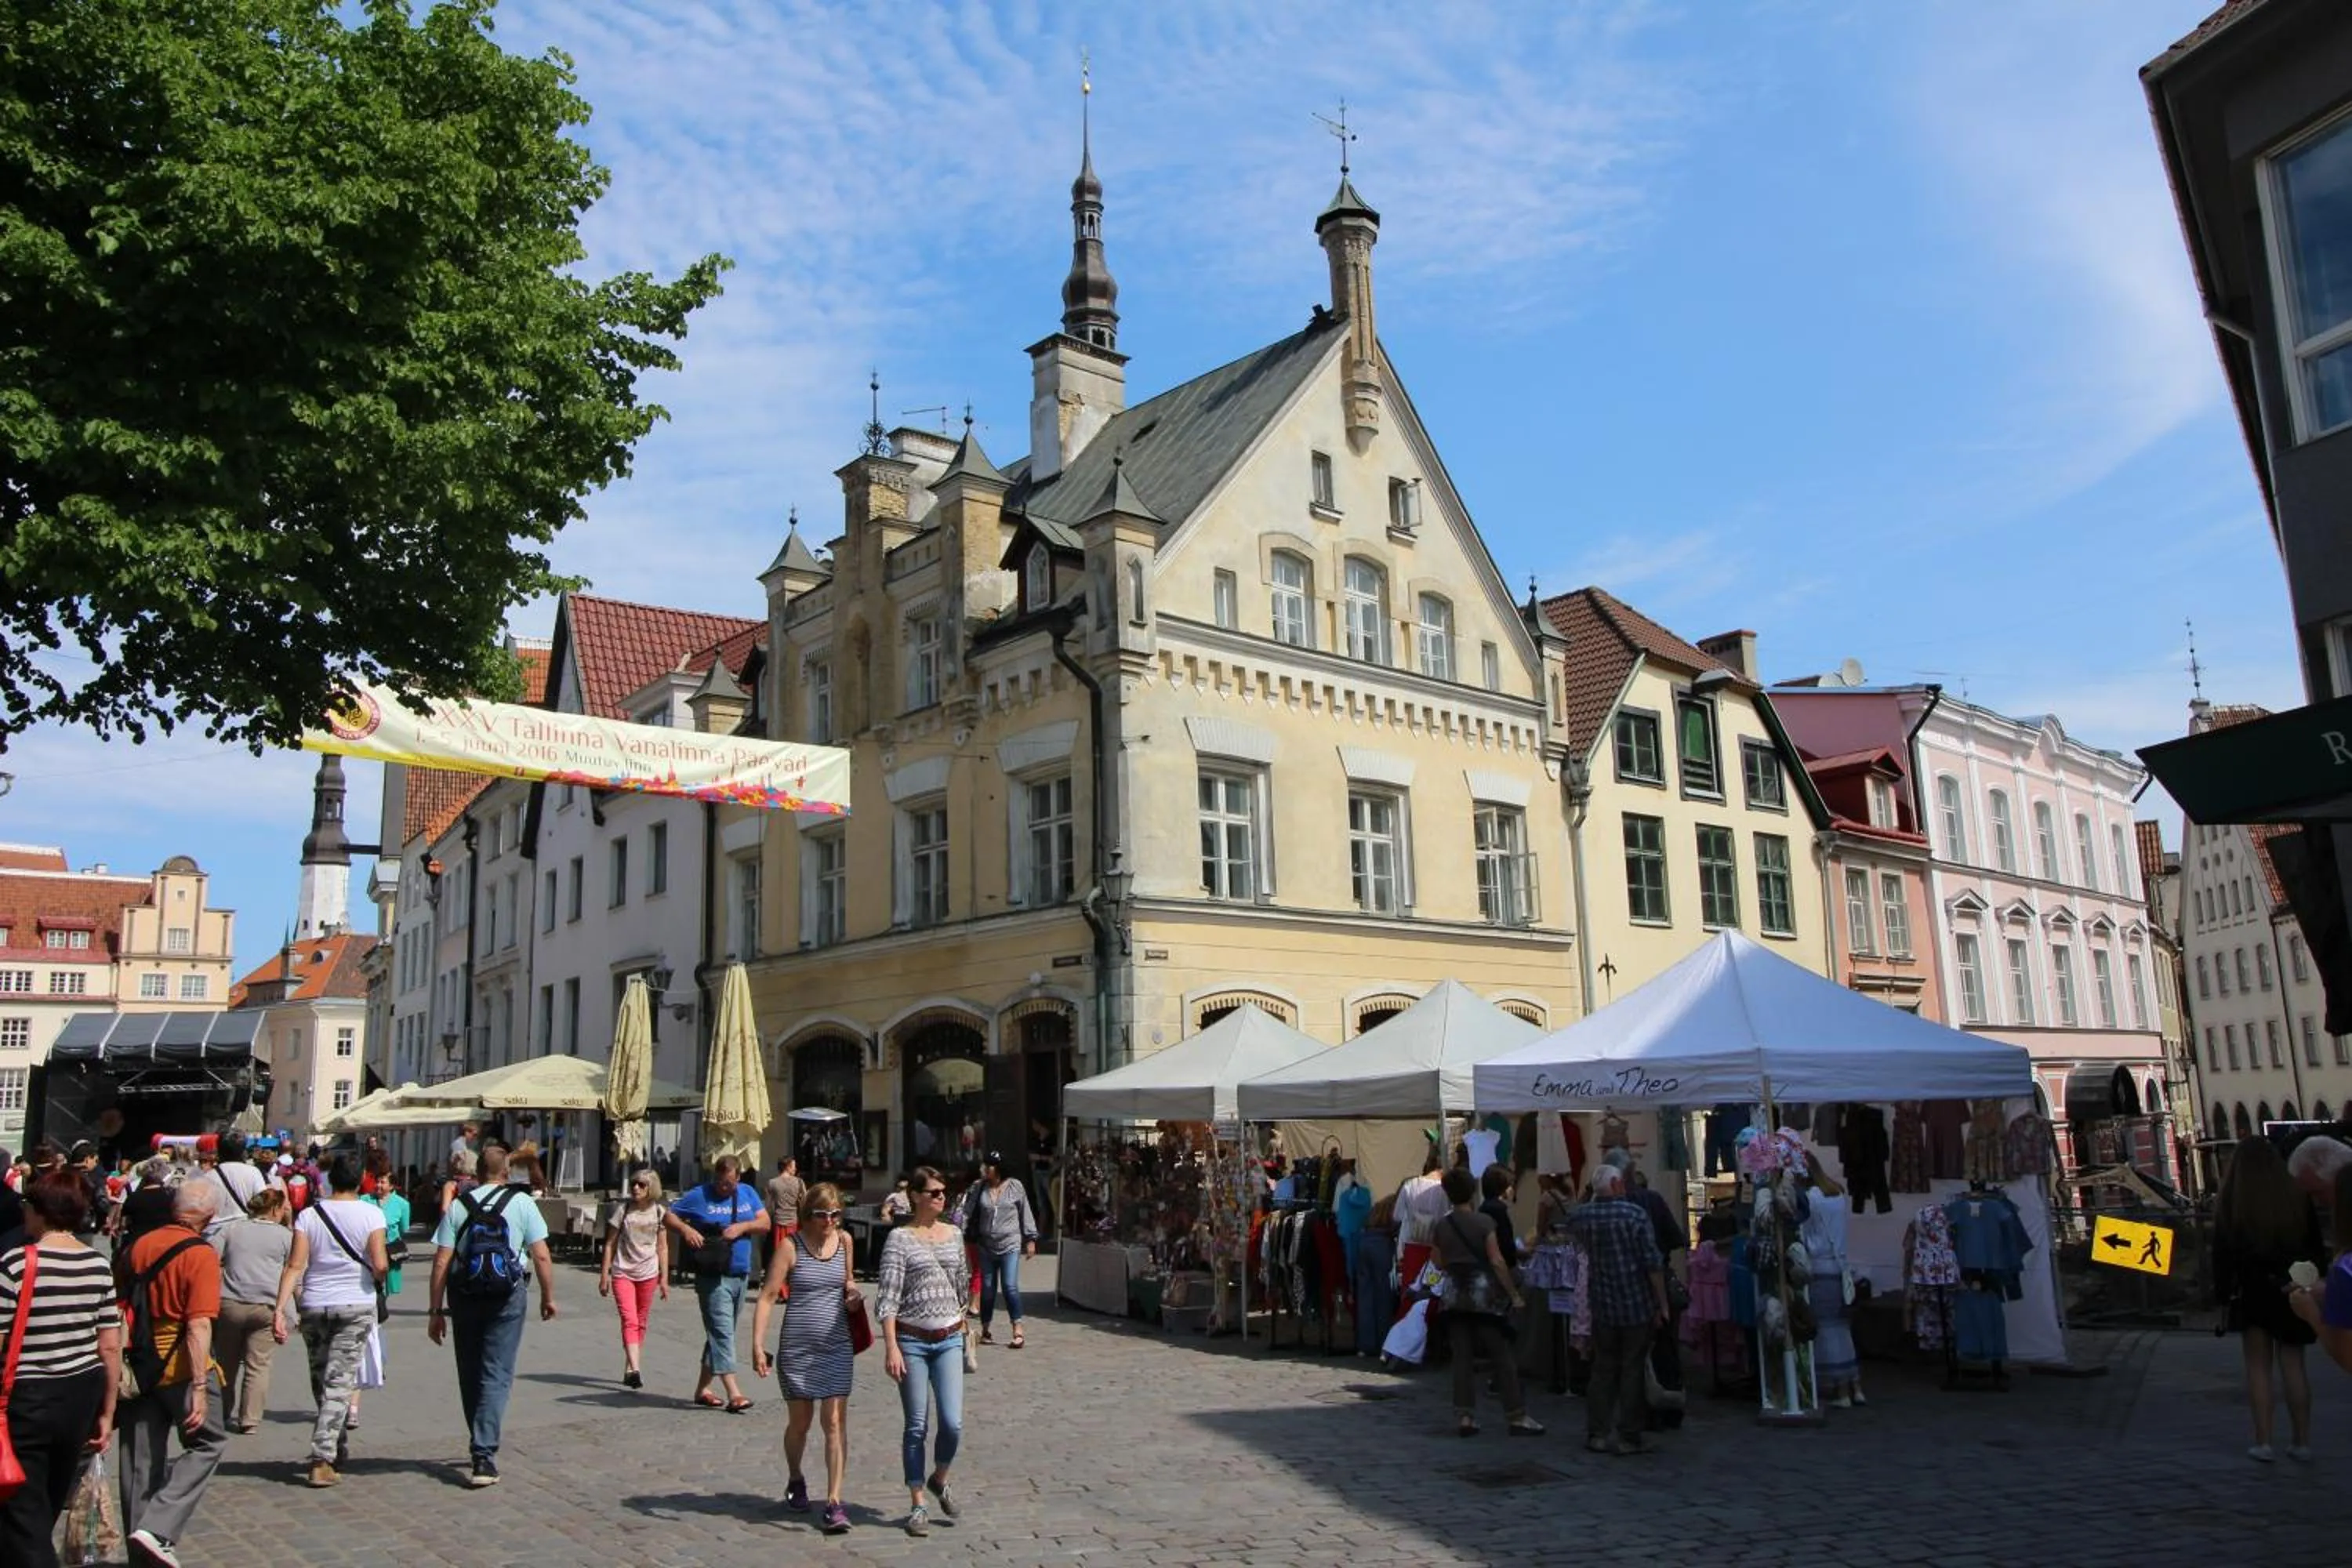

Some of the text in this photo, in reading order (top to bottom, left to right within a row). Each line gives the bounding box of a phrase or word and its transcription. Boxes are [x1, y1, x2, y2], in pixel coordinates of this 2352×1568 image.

[506, 717, 604, 749] Tallinna
[614, 731, 725, 764] Vanalinna
[516, 742, 557, 762] 2016
[1531, 1073, 1593, 1098] Emma
[1615, 1066, 1679, 1097] Theo
